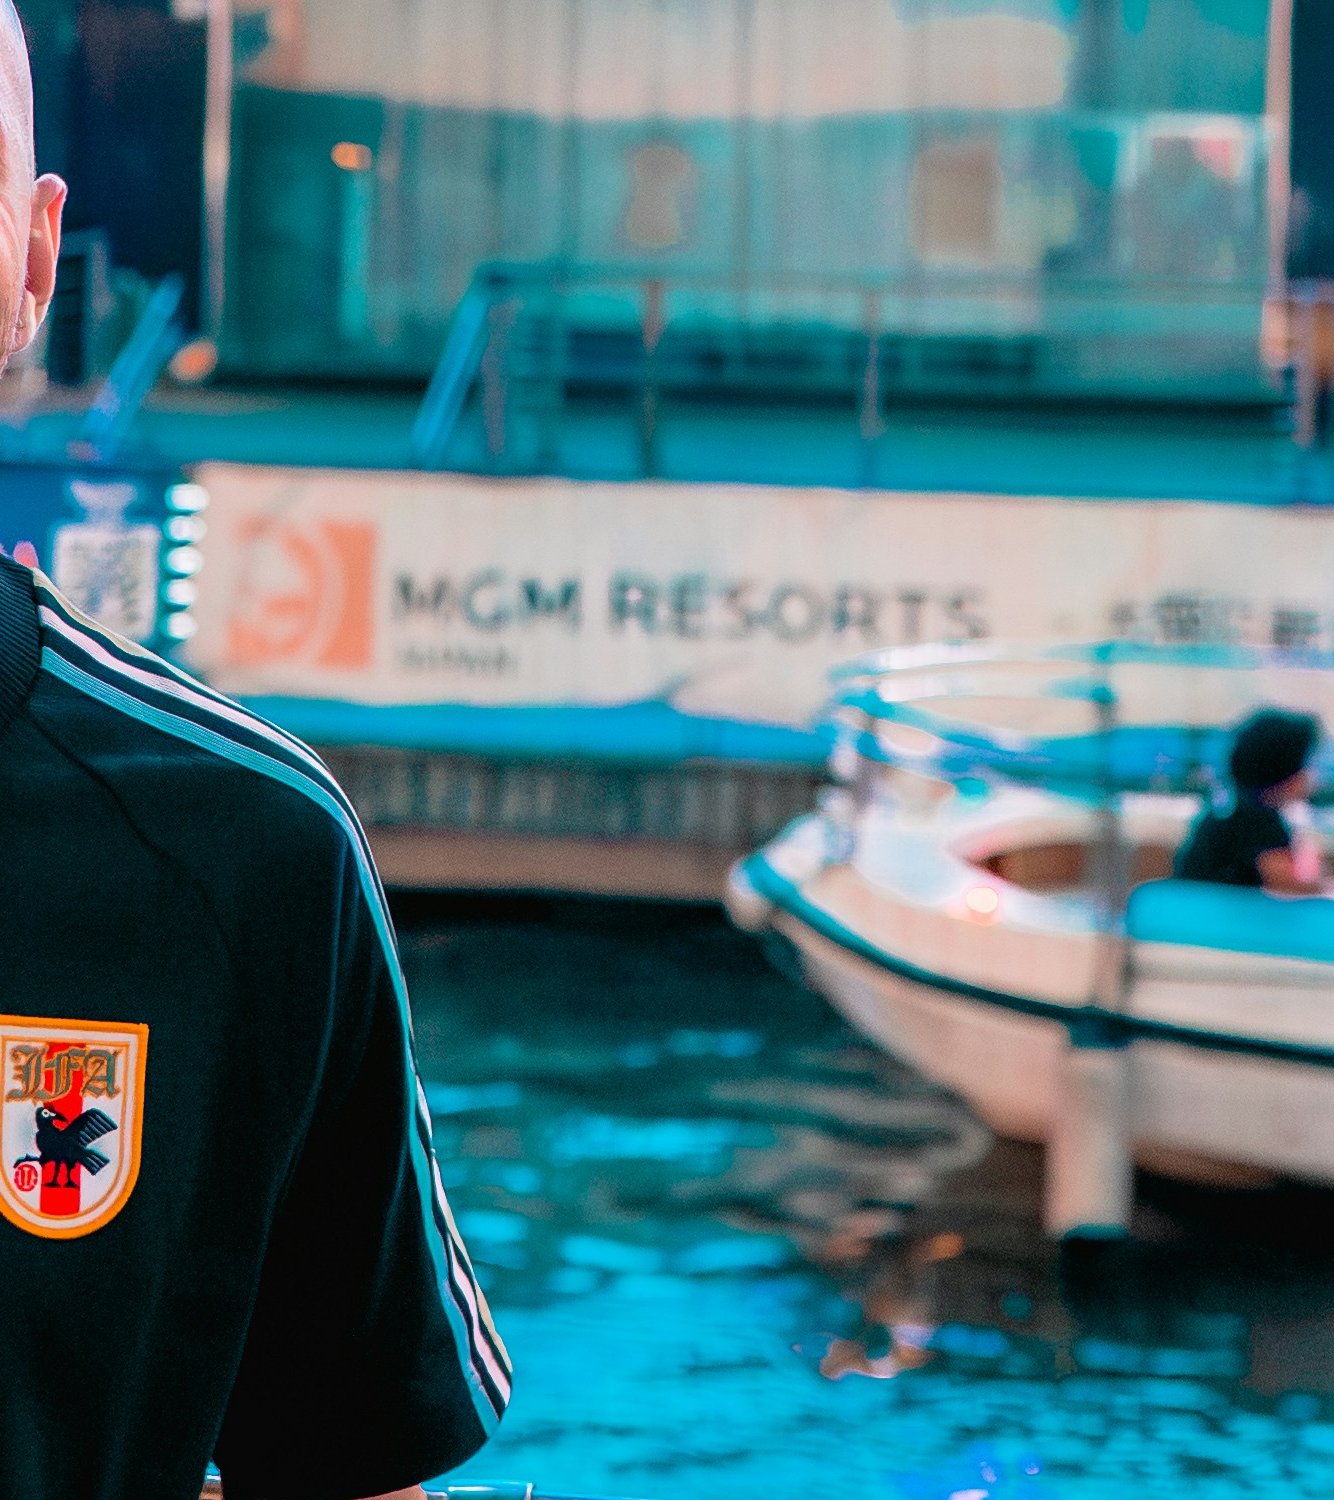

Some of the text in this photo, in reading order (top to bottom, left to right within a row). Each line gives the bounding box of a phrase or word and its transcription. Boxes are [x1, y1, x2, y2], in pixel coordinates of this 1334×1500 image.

[392, 565, 991, 642] MGM RESORTS
[5, 1043, 123, 1103] JFA
